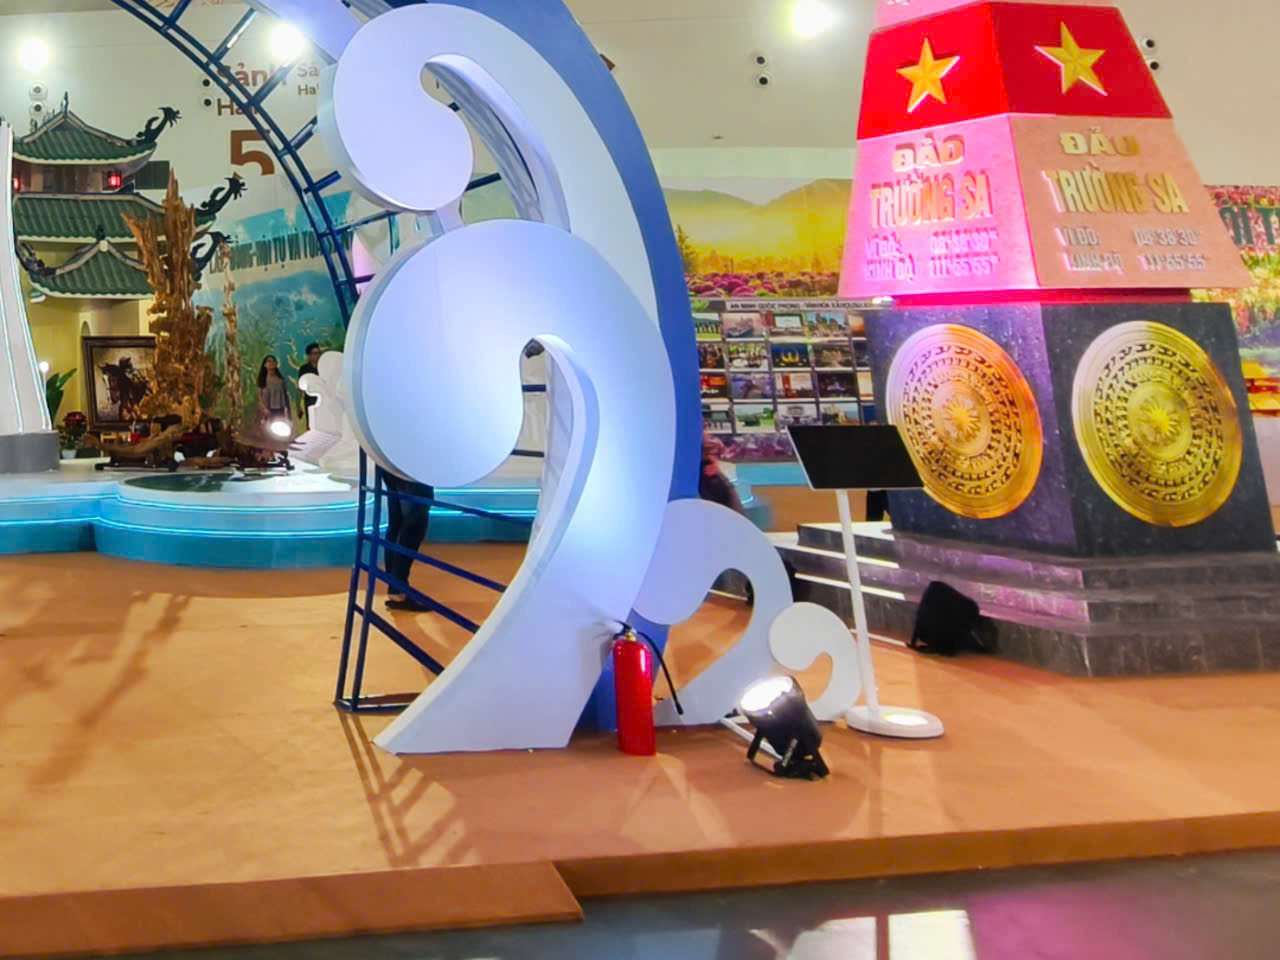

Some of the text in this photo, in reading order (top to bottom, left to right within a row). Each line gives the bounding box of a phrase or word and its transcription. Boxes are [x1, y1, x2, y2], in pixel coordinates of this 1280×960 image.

[230, 129, 275, 176] 5
[961, 170, 993, 219] SA
[1147, 172, 1190, 213] SA
